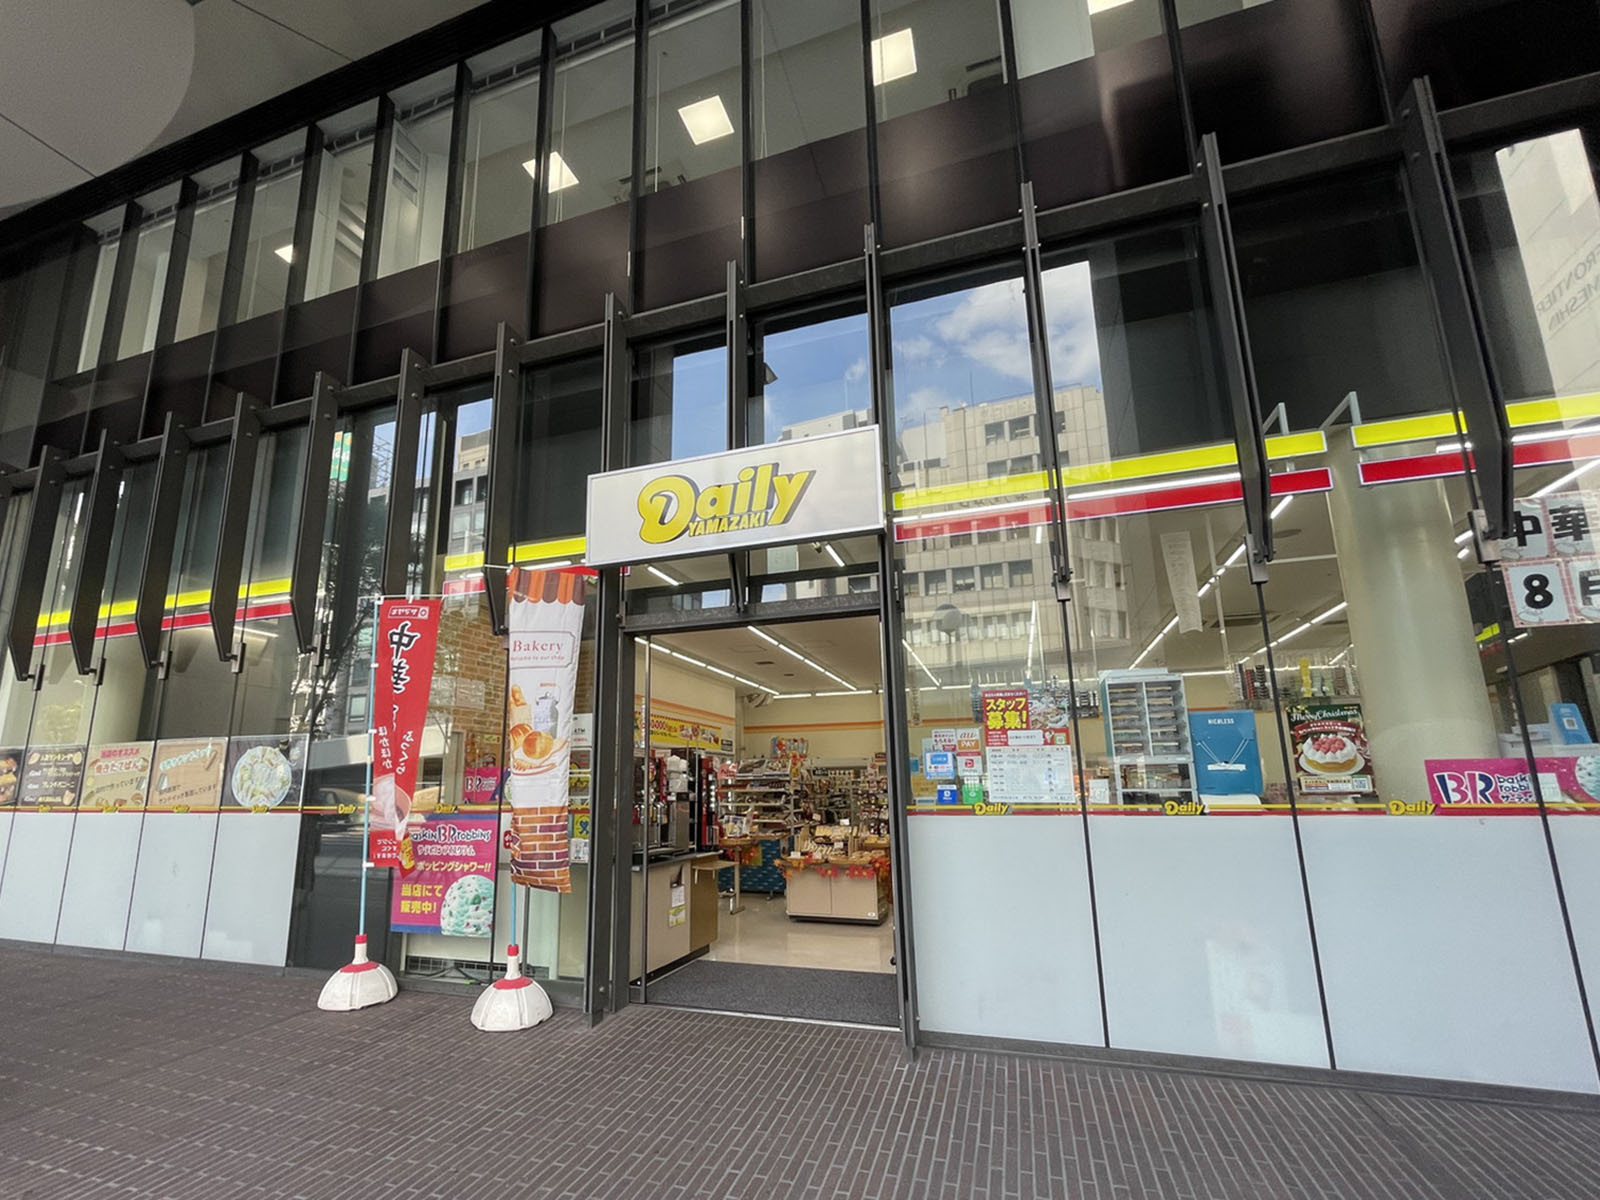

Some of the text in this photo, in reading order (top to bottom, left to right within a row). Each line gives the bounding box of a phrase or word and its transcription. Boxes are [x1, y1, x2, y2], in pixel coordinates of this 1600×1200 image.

[637, 462, 816, 545] Daily
[688, 511, 768, 538] YAMAZAKI
[513, 640, 563, 655] Bakery
[986, 697, 1027, 711] スタッフ
[986, 710, 1028, 730] 募集!
[1495, 773, 1528, 784] bask
[1433, 771, 1494, 805] BR
[1498, 783, 1530, 793] robbi
[974, 802, 1009, 815] Daily
[1165, 800, 1204, 815] Daily
[1388, 800, 1437, 815] Daily
[401, 883, 444, 898] 当店にて
[400, 899, 438, 914] 販売中!
